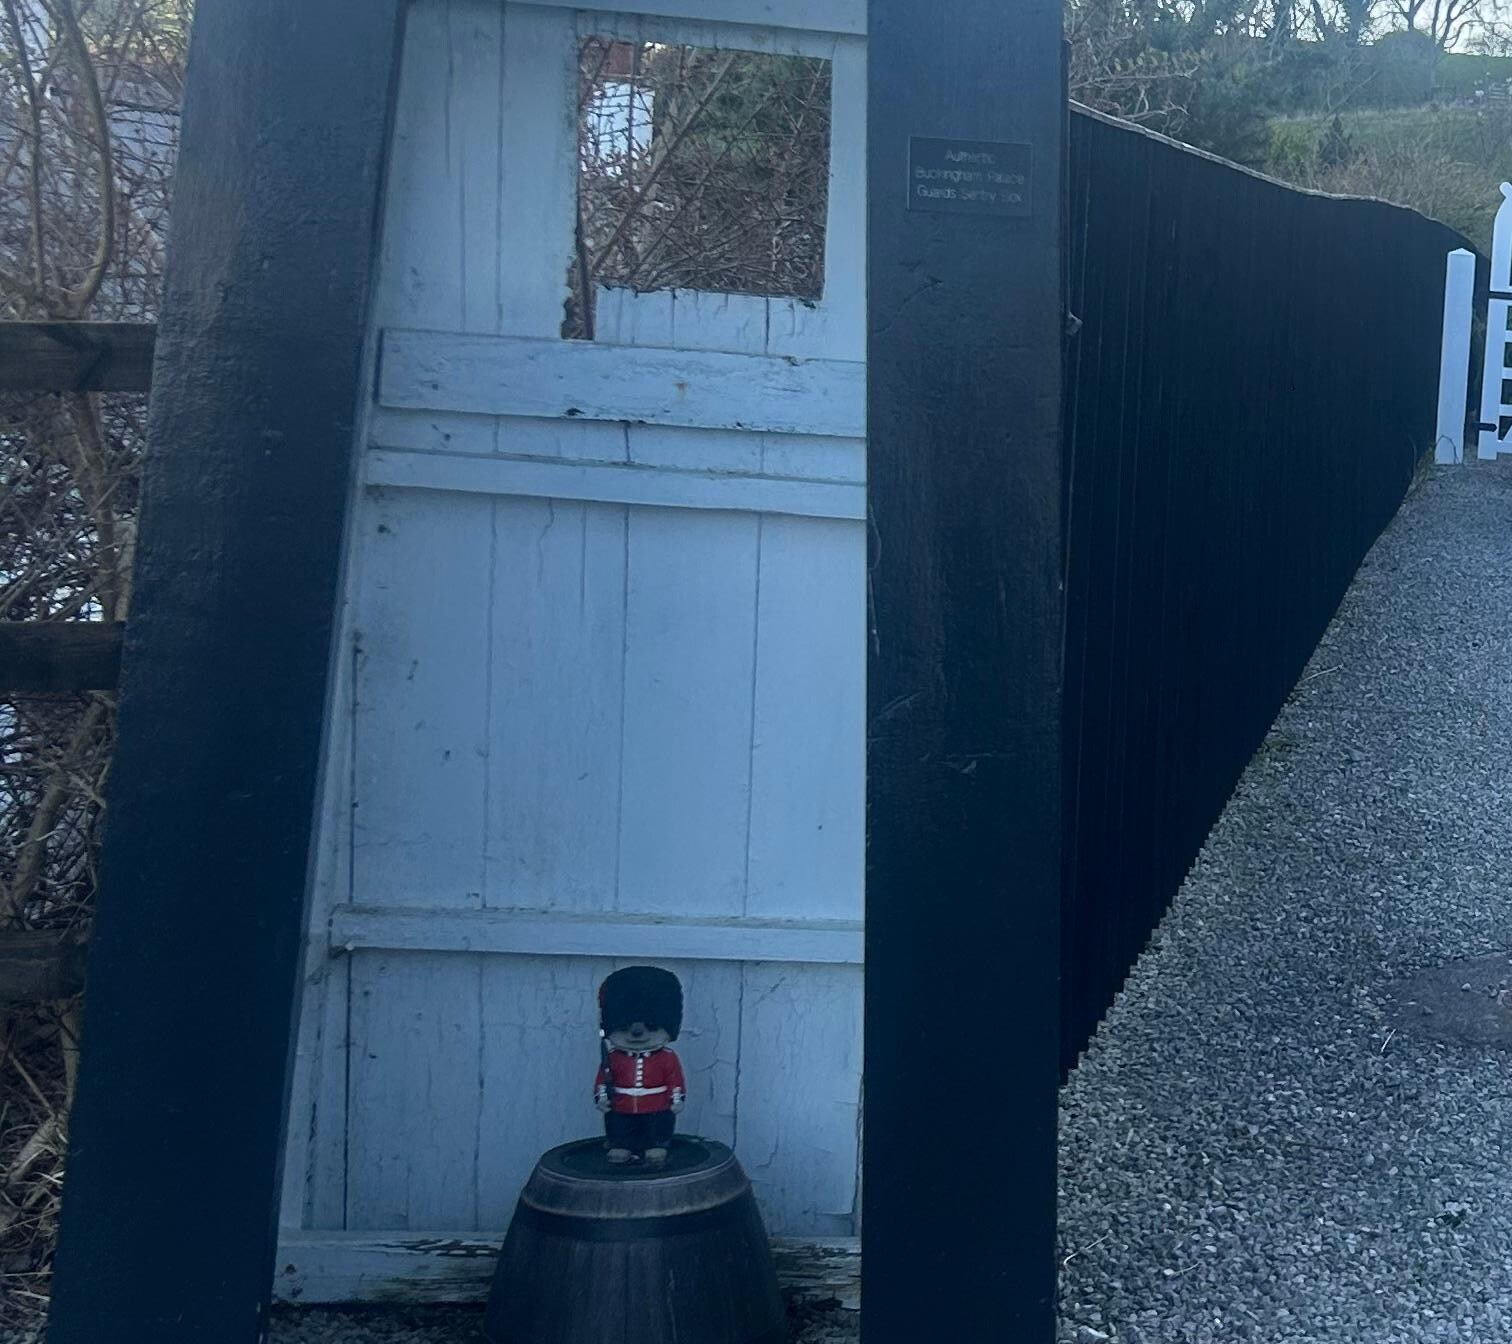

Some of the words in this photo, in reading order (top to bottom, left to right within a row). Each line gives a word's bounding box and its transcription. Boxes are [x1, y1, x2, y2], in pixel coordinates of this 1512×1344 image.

[915, 166, 982, 183] Buckingham
[986, 170, 1025, 185] Palace
[917, 184, 957, 199] Guards
[960, 188, 997, 202] Sentry
